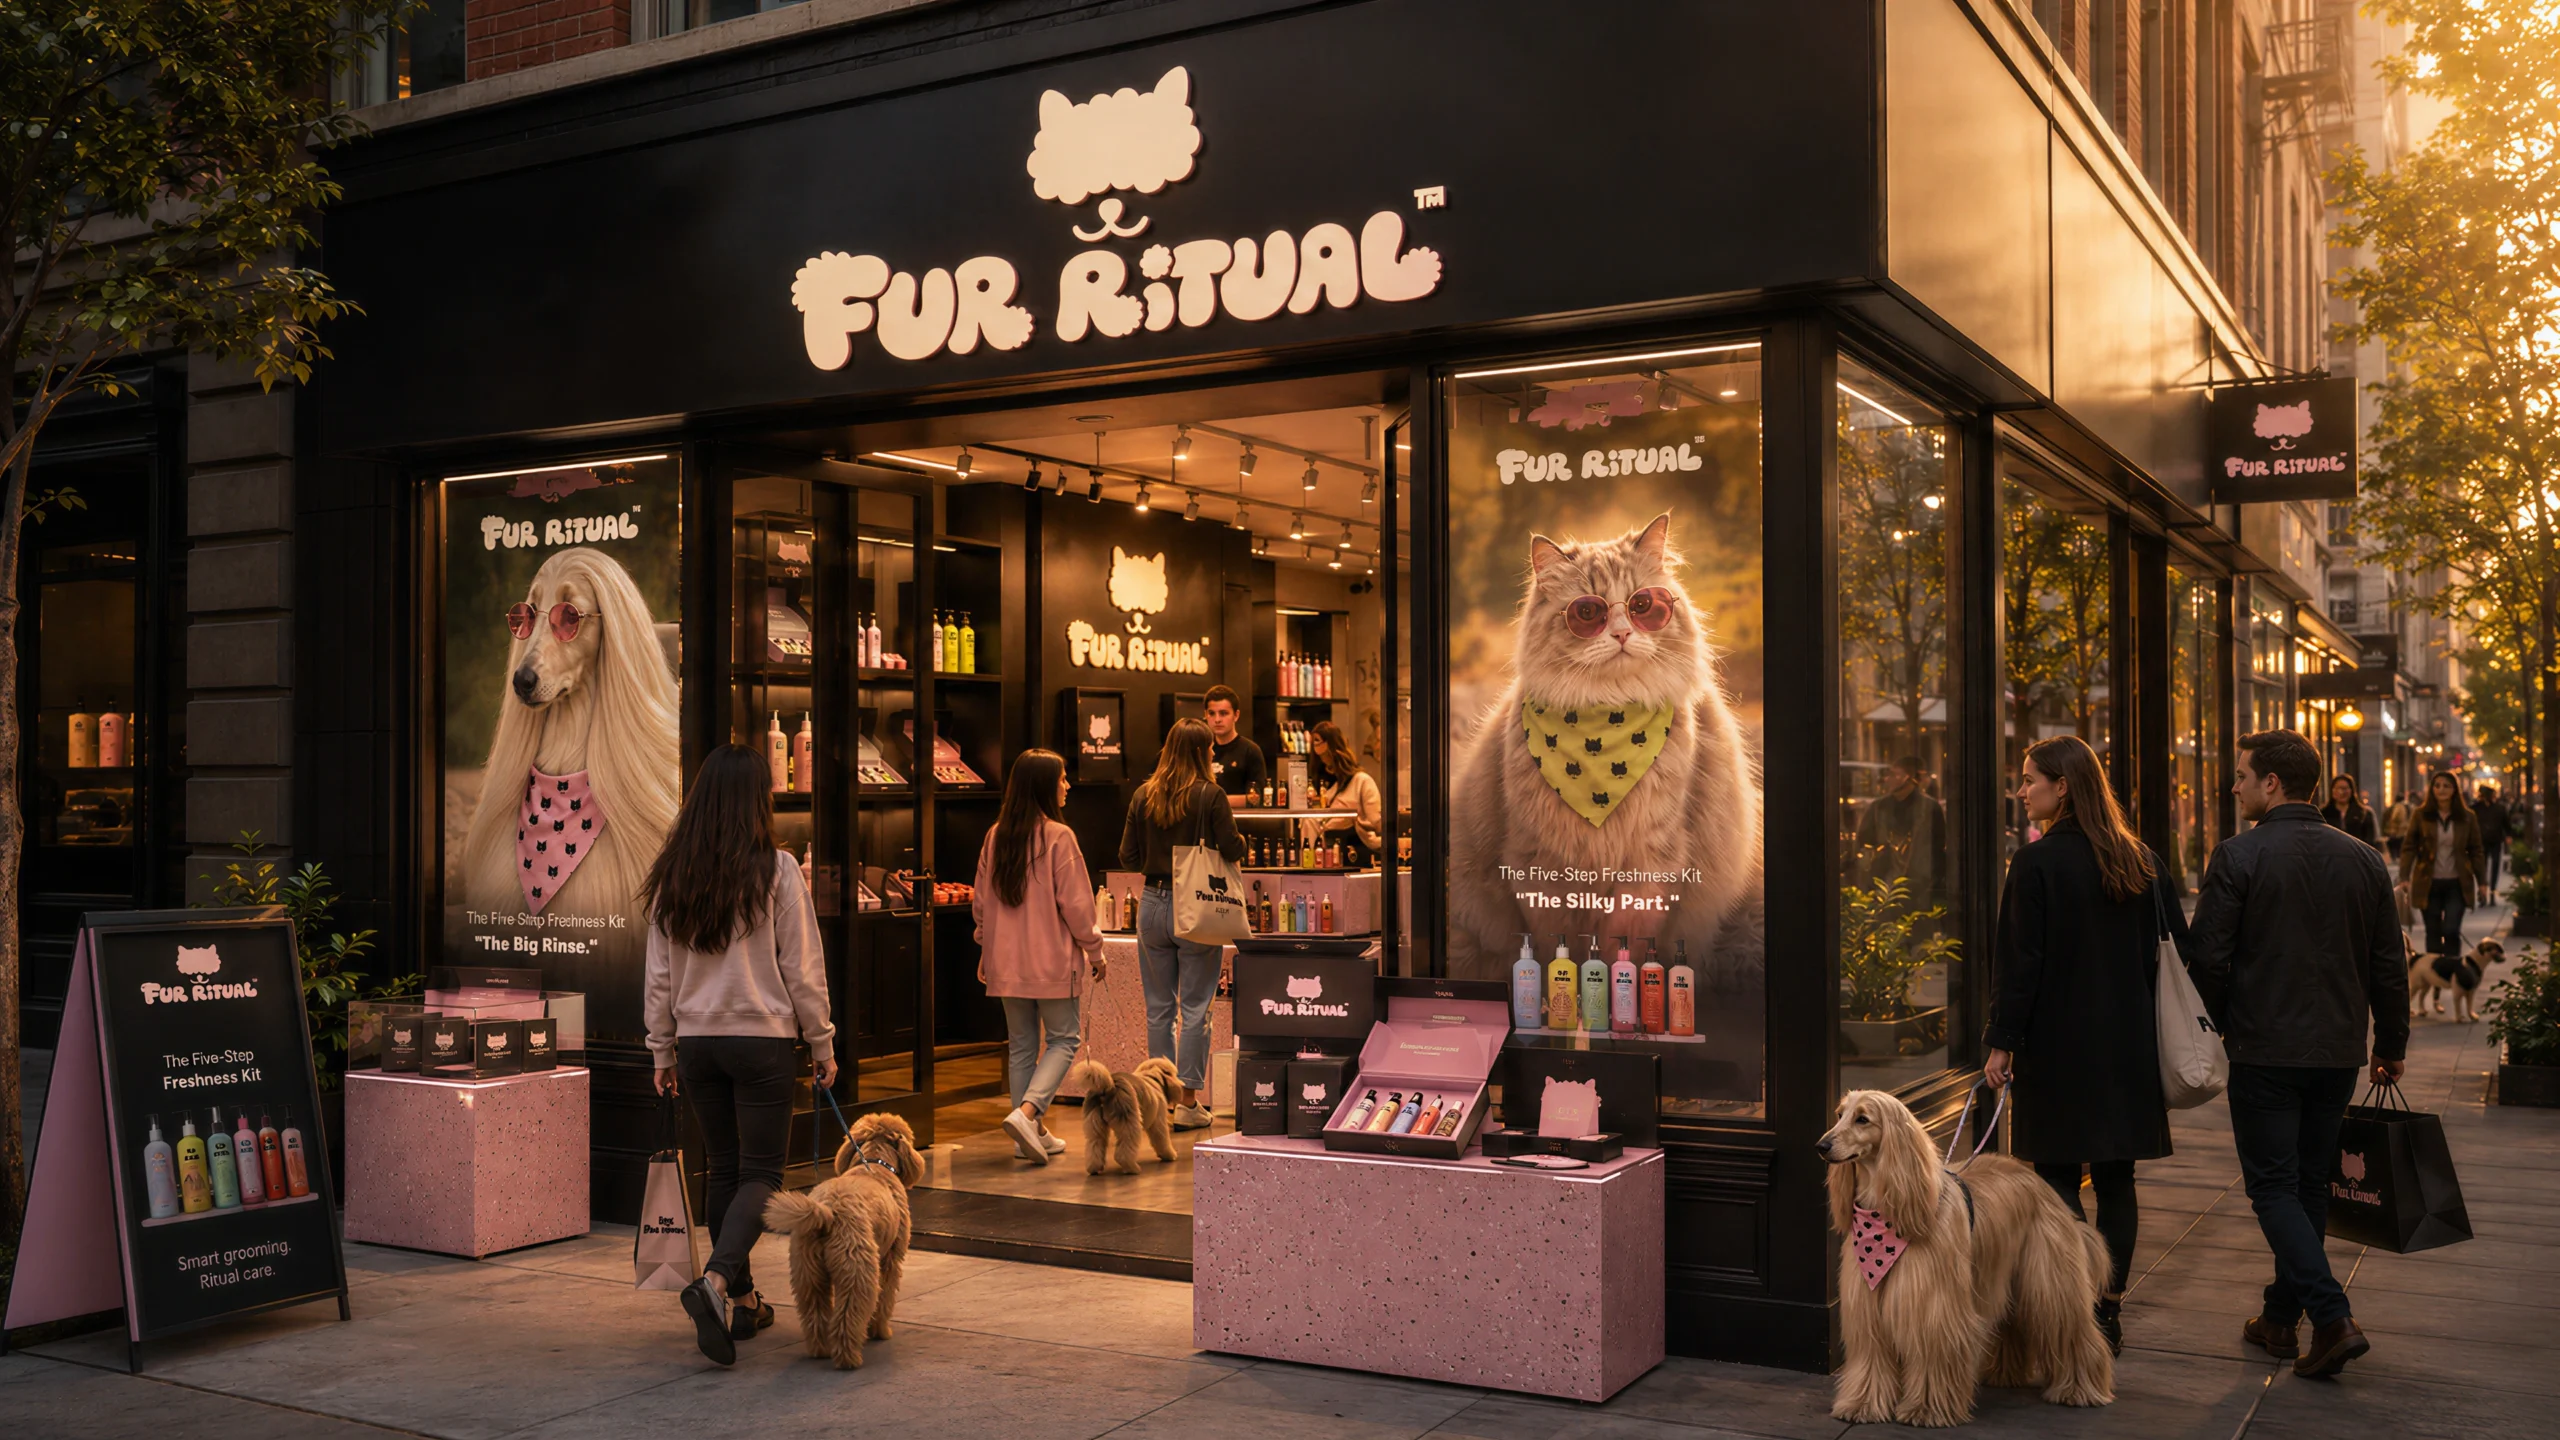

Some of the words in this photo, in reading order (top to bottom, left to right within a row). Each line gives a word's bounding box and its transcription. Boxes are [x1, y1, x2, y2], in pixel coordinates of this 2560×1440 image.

[791, 251, 1035, 371] FUR
[1496, 449, 1573, 485] FUR
[2224, 457, 2270, 478] FUR
[480, 515, 538, 550] FUR
[1066, 619, 1125, 669] FUR
[1499, 866, 1525, 880] The
[1529, 866, 1598, 885] Five-Step
[1602, 868, 1677, 883] Freshness
[1681, 868, 1702, 883] Kit
[1516, 892, 1561, 908] "The
[1566, 892, 1615, 913] Silky
[1621, 894, 1680, 911] Part."
[466, 911, 488, 925] The
[548, 913, 606, 928] Freshness
[609, 914, 626, 929] Kit
[475, 935, 510, 951] "The
[513, 936, 539, 955] Big
[542, 937, 598, 954] Rinse."
[140, 982, 189, 1005] FUR
[1260, 999, 1294, 1015] FUR
[163, 1054, 190, 1068] The
[192, 1049, 254, 1065] Five-Step
[163, 1073, 238, 1090] Freshness
[241, 1068, 262, 1082] Kit
[178, 1251, 220, 1271] Smart
[223, 1240, 292, 1266] grooming.
[200, 1268, 240, 1289] Ritual
[243, 1264, 276, 1281] care.
